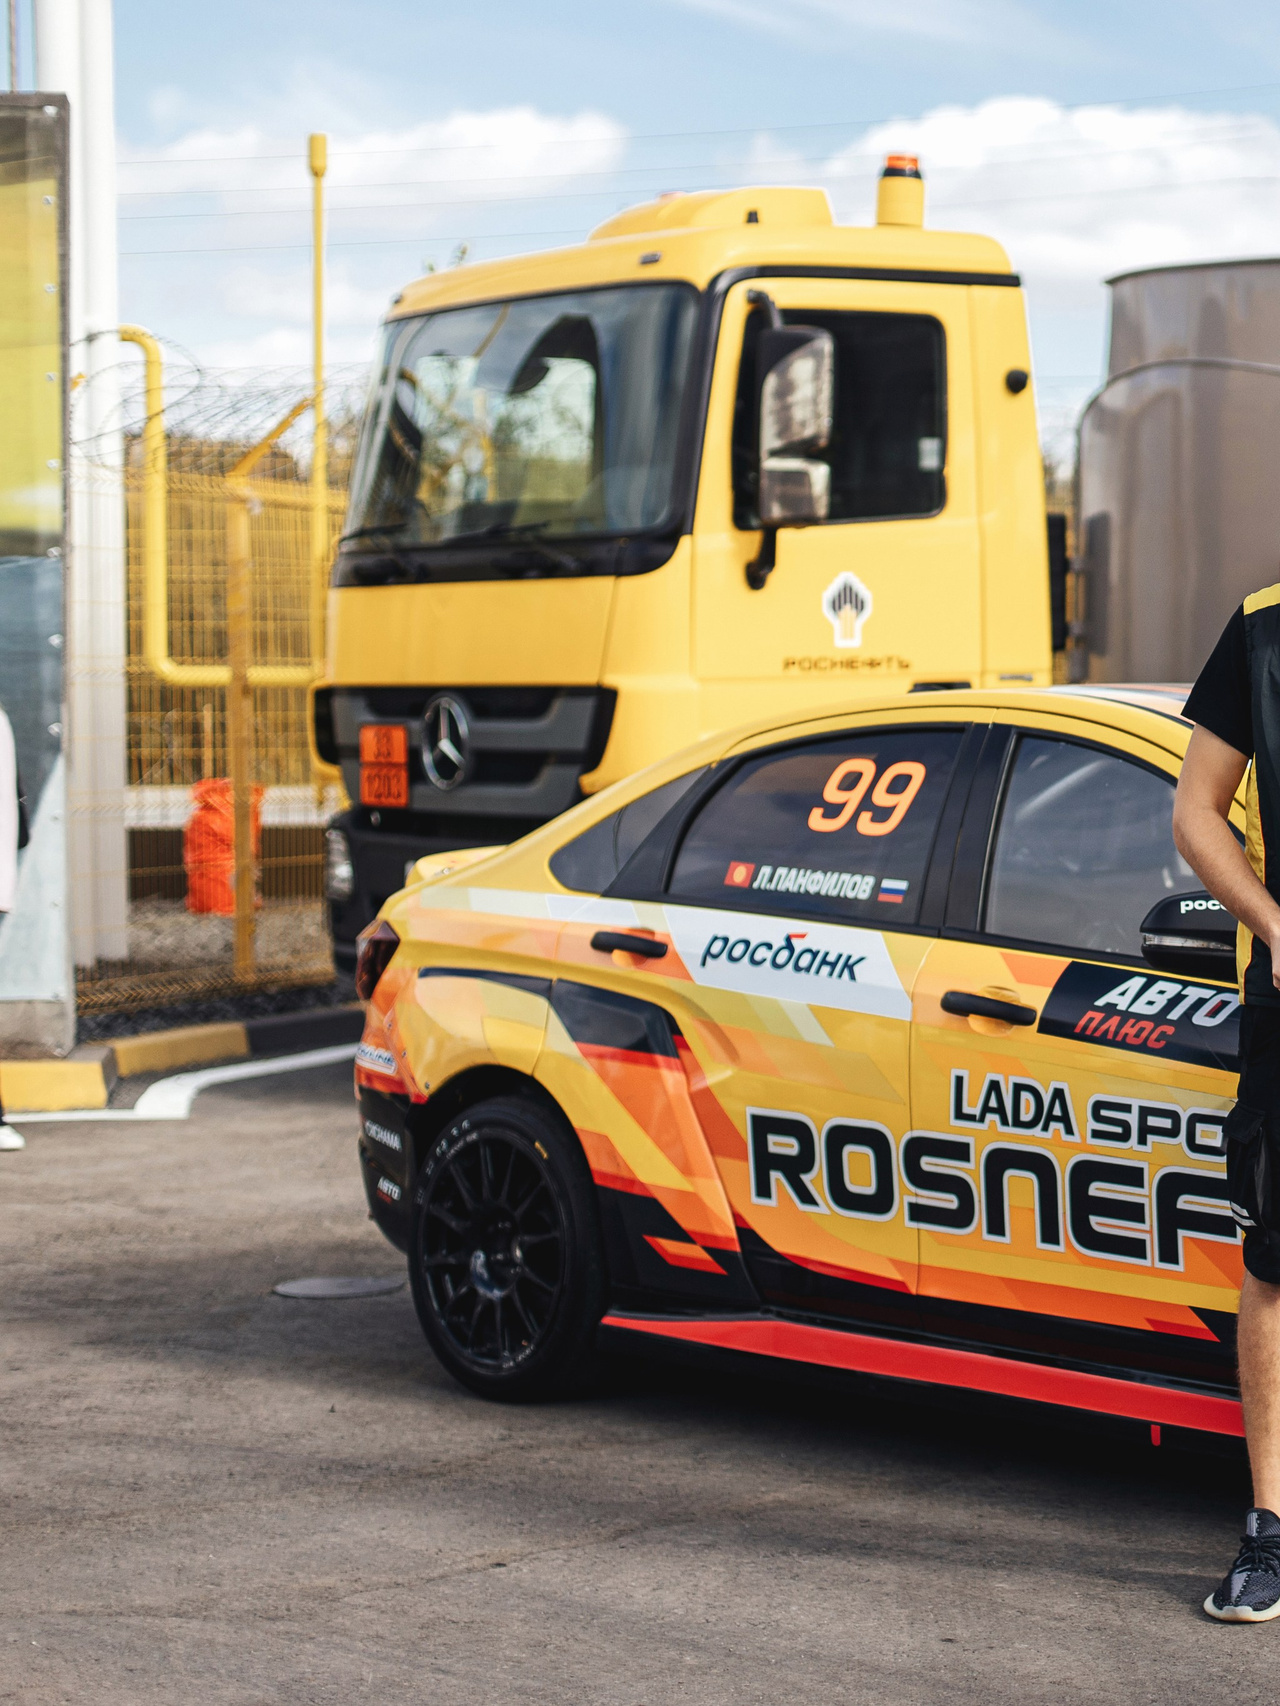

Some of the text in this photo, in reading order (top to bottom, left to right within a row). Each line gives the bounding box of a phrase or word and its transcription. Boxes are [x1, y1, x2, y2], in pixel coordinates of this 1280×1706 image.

[783, 655, 910, 672] РОСНЕФТЬ
[807, 758, 926, 837] 99
[752, 865, 876, 900] Л.ПАНФИЛОВ
[700, 932, 867, 982] росбанк
[1094, 975, 1239, 1027] АВТО
[1073, 1010, 1176, 1049] ПЛЮС
[950, 1068, 1228, 1162] LADA SPO
[746, 1106, 1242, 1273] ROSNEF
